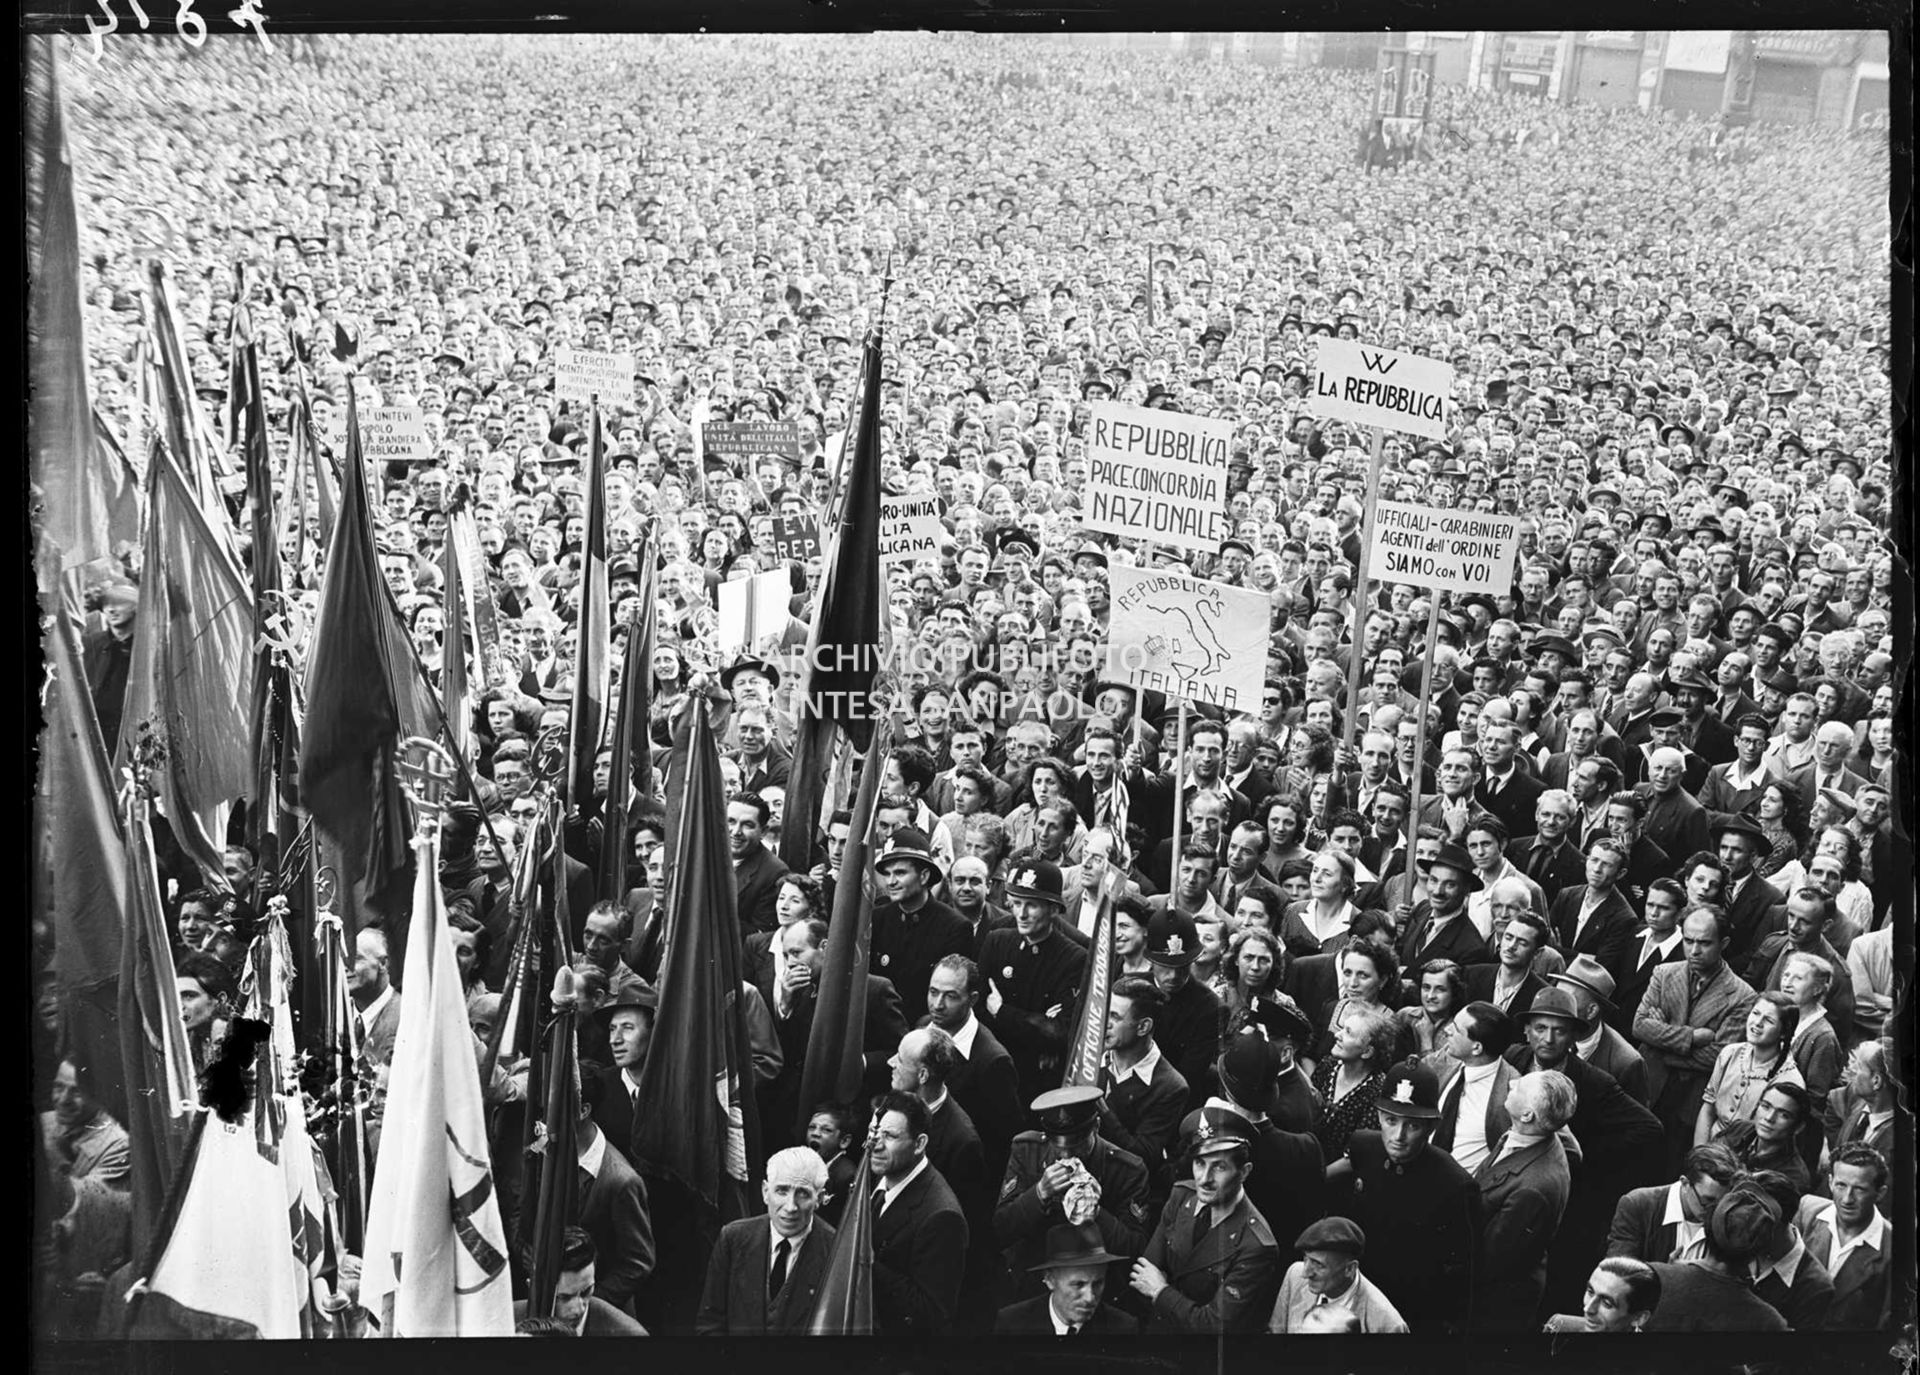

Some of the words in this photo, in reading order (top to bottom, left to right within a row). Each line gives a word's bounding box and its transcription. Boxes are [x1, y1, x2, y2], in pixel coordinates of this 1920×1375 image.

[1361, 350, 1398, 375] W
[1344, 376, 1443, 422] REPUBBLICA
[374, 411, 412, 421] UNITEVI
[749, 423, 790, 432] LAVORO
[379, 434, 422, 445] BANDIERA
[708, 443, 788, 453] REPUBBLICANA
[1380, 529, 1424, 550] AGENTI
[1385, 551, 1435, 576] SIAMO
[1462, 562, 1490, 583] VOI
[1117, 577, 1220, 612] REPUBBLICA
[1130, 668, 1238, 710] ITALIANA
[1082, 1002, 1102, 1082] OFFICINE
